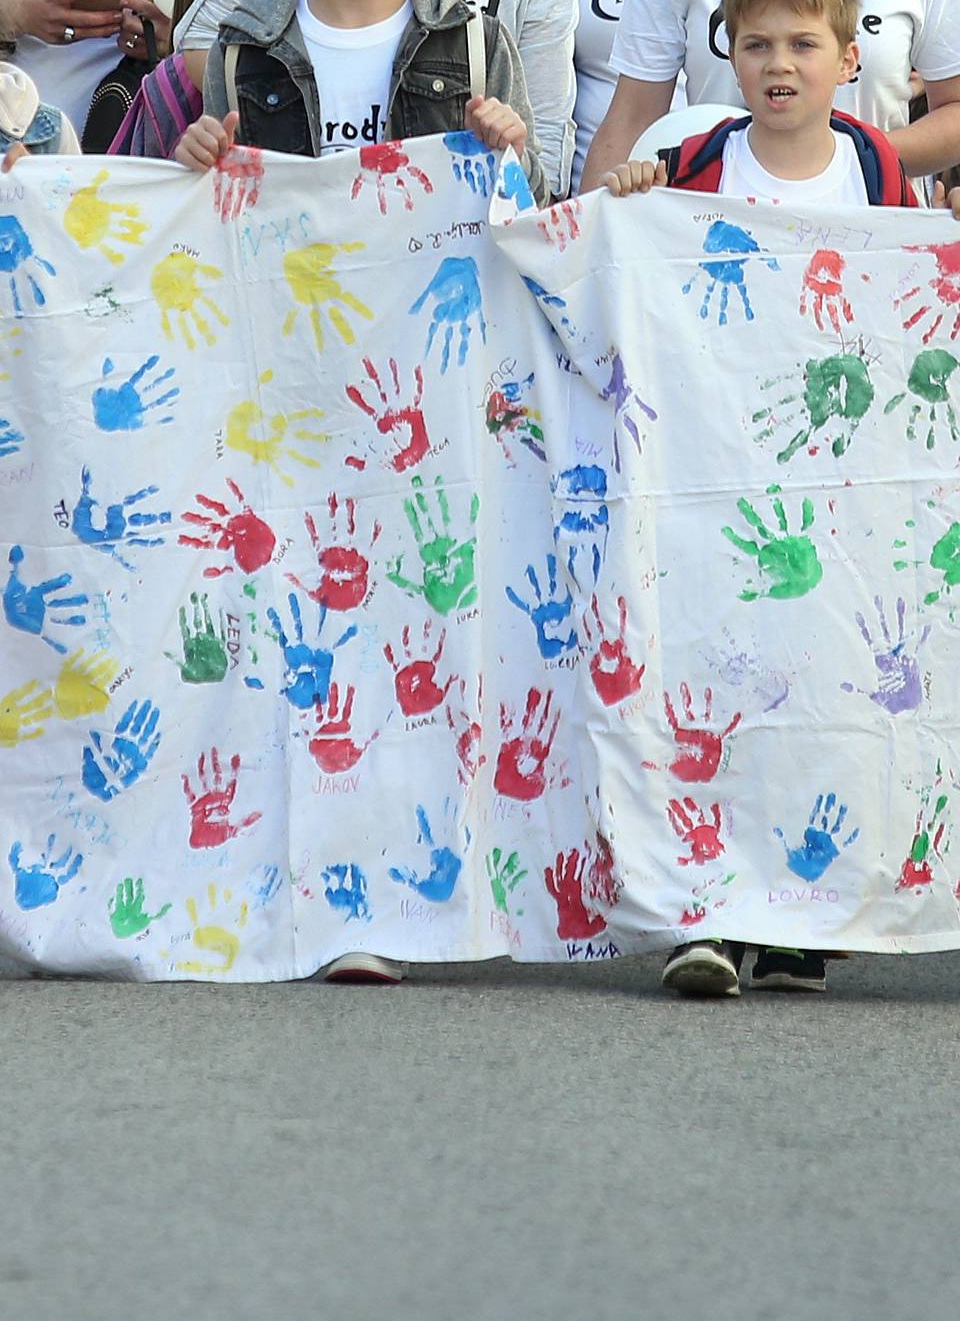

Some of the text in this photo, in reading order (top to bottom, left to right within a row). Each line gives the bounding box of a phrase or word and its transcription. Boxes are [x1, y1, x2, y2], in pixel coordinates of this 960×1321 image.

[575, 436, 603, 458] MIA
[53, 498, 70, 529] TEO
[273, 536, 296, 566] DORA
[226, 612, 241, 671] LEDA
[404, 715, 437, 732] LAURA
[311, 774, 361, 795] JAKOV
[767, 889, 840, 905] LOVRO
